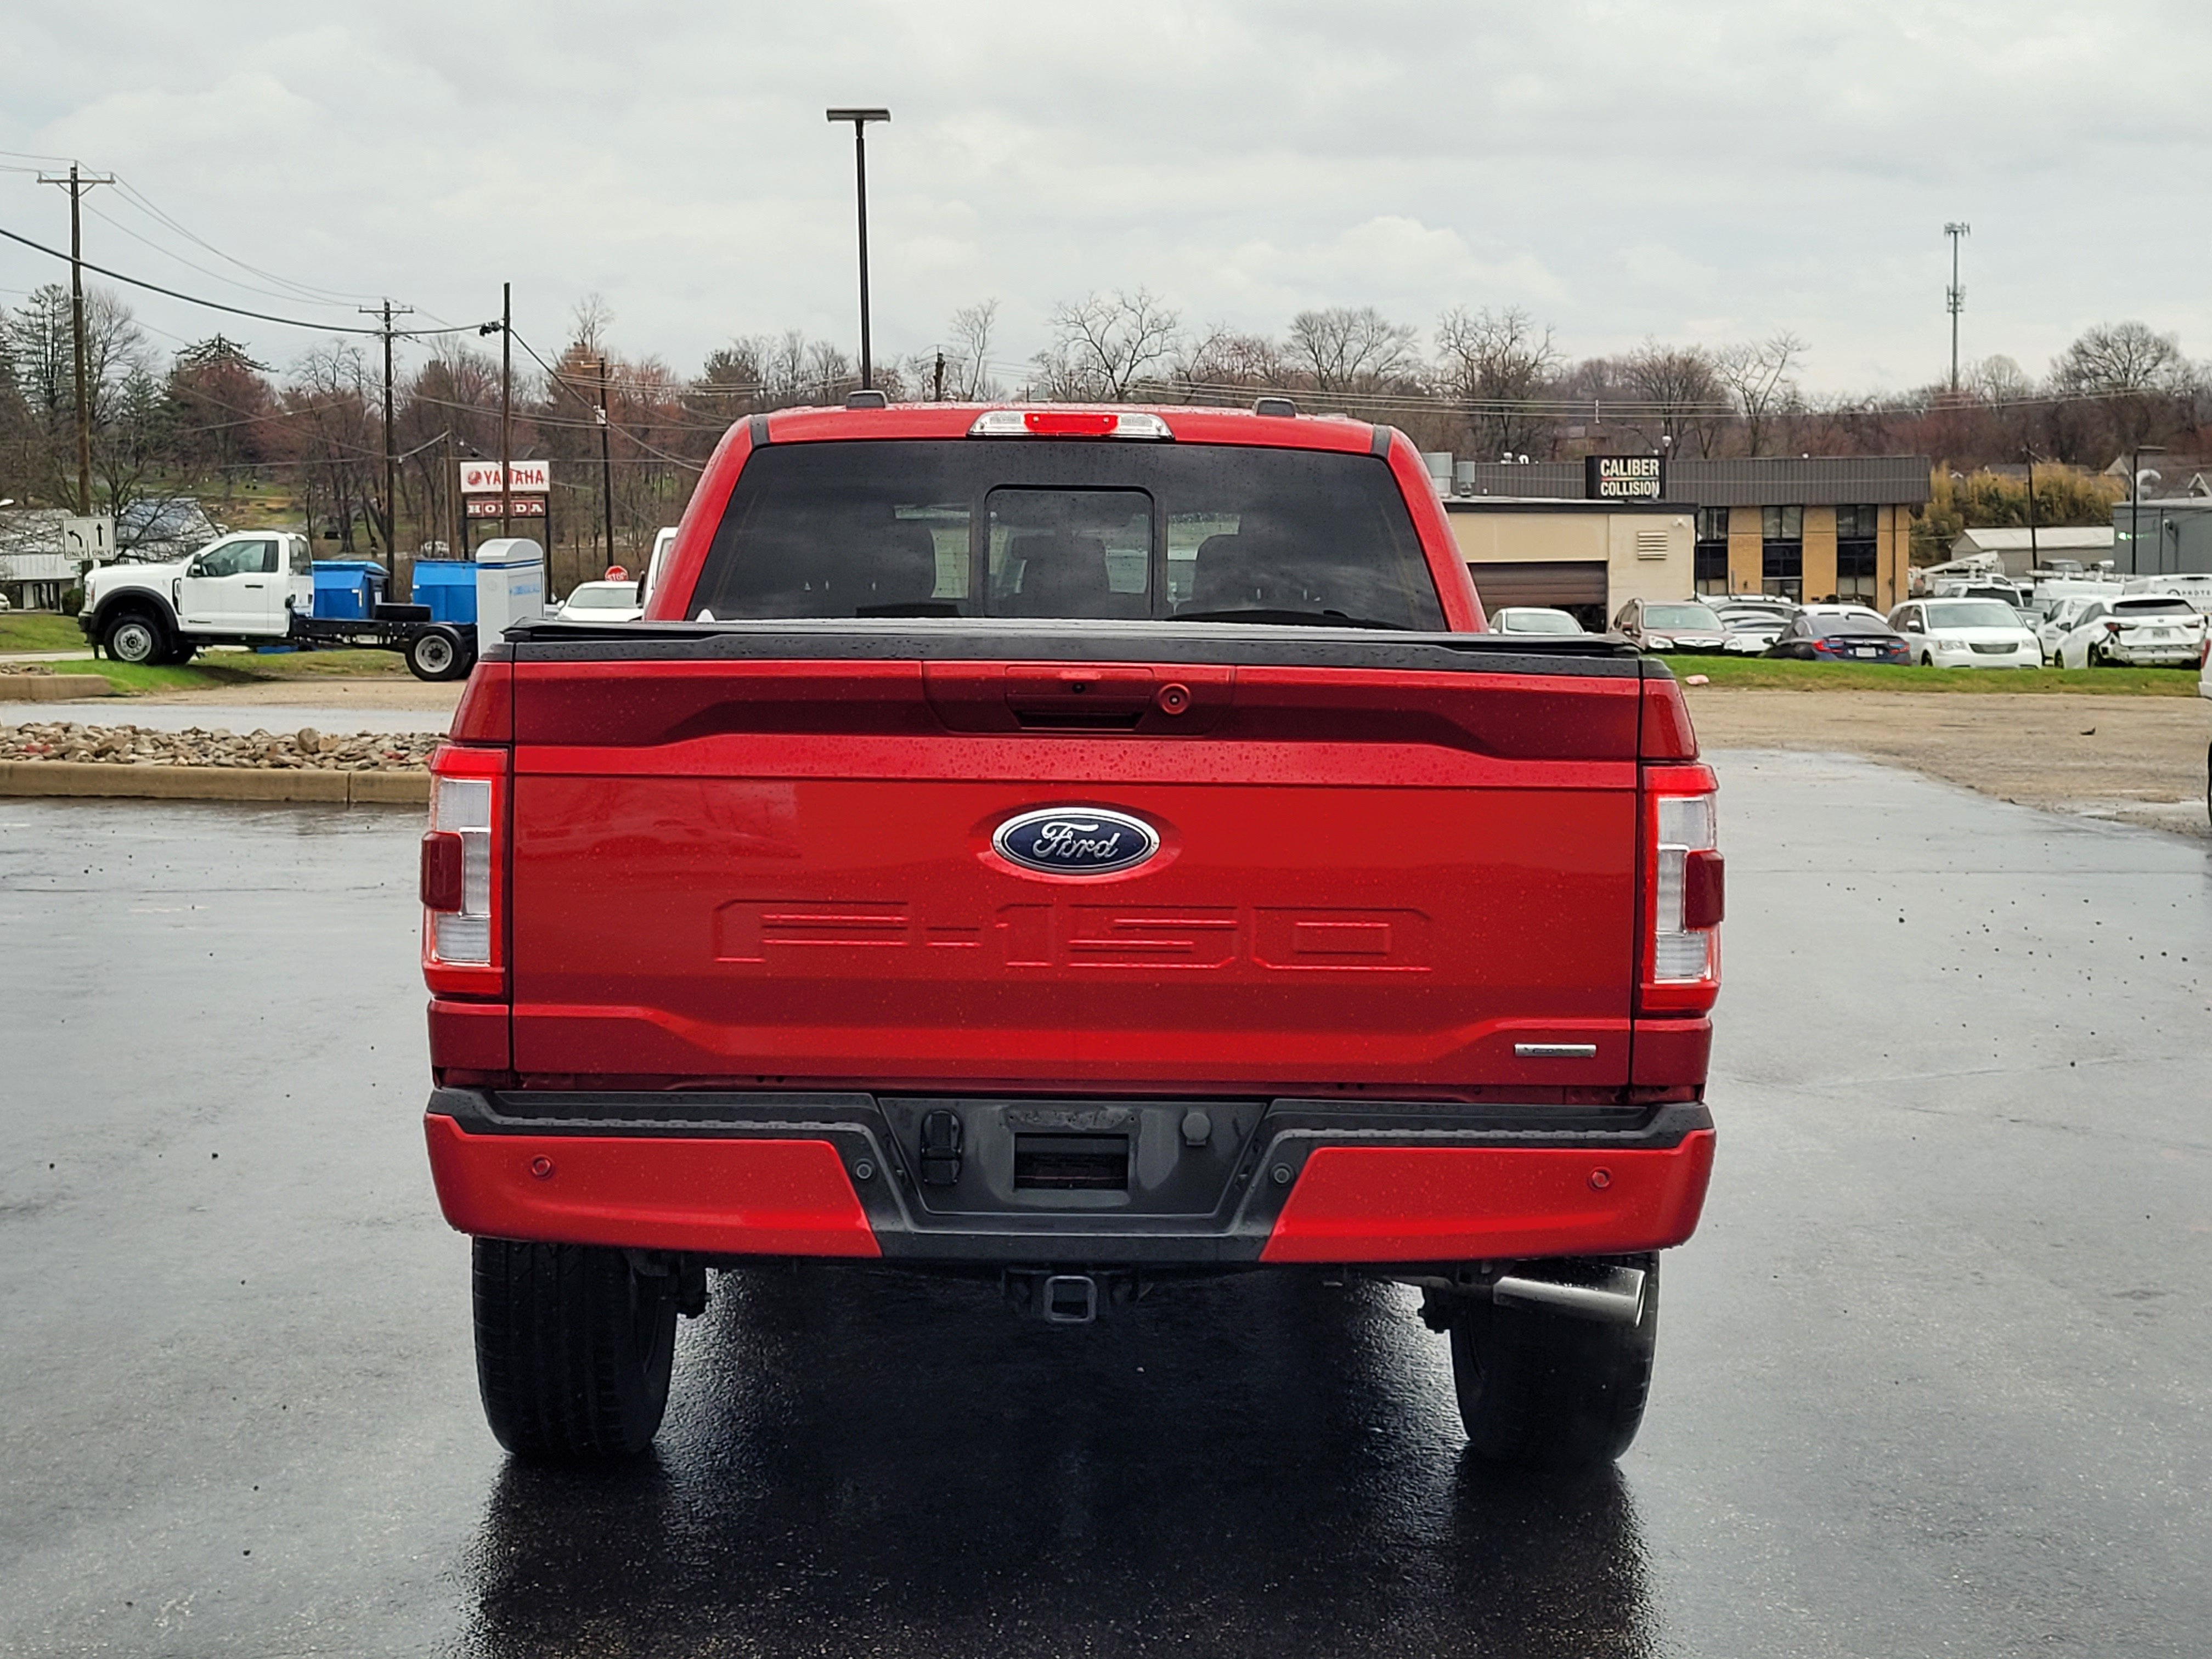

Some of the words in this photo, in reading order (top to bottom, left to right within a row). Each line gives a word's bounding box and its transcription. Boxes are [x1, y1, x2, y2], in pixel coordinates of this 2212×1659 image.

[1600, 459, 1660, 476] CALIBER
[1600, 481, 1660, 496] COLLISION
[1032, 822, 1120, 858] Ford
[715, 900, 1431, 971] F-150
